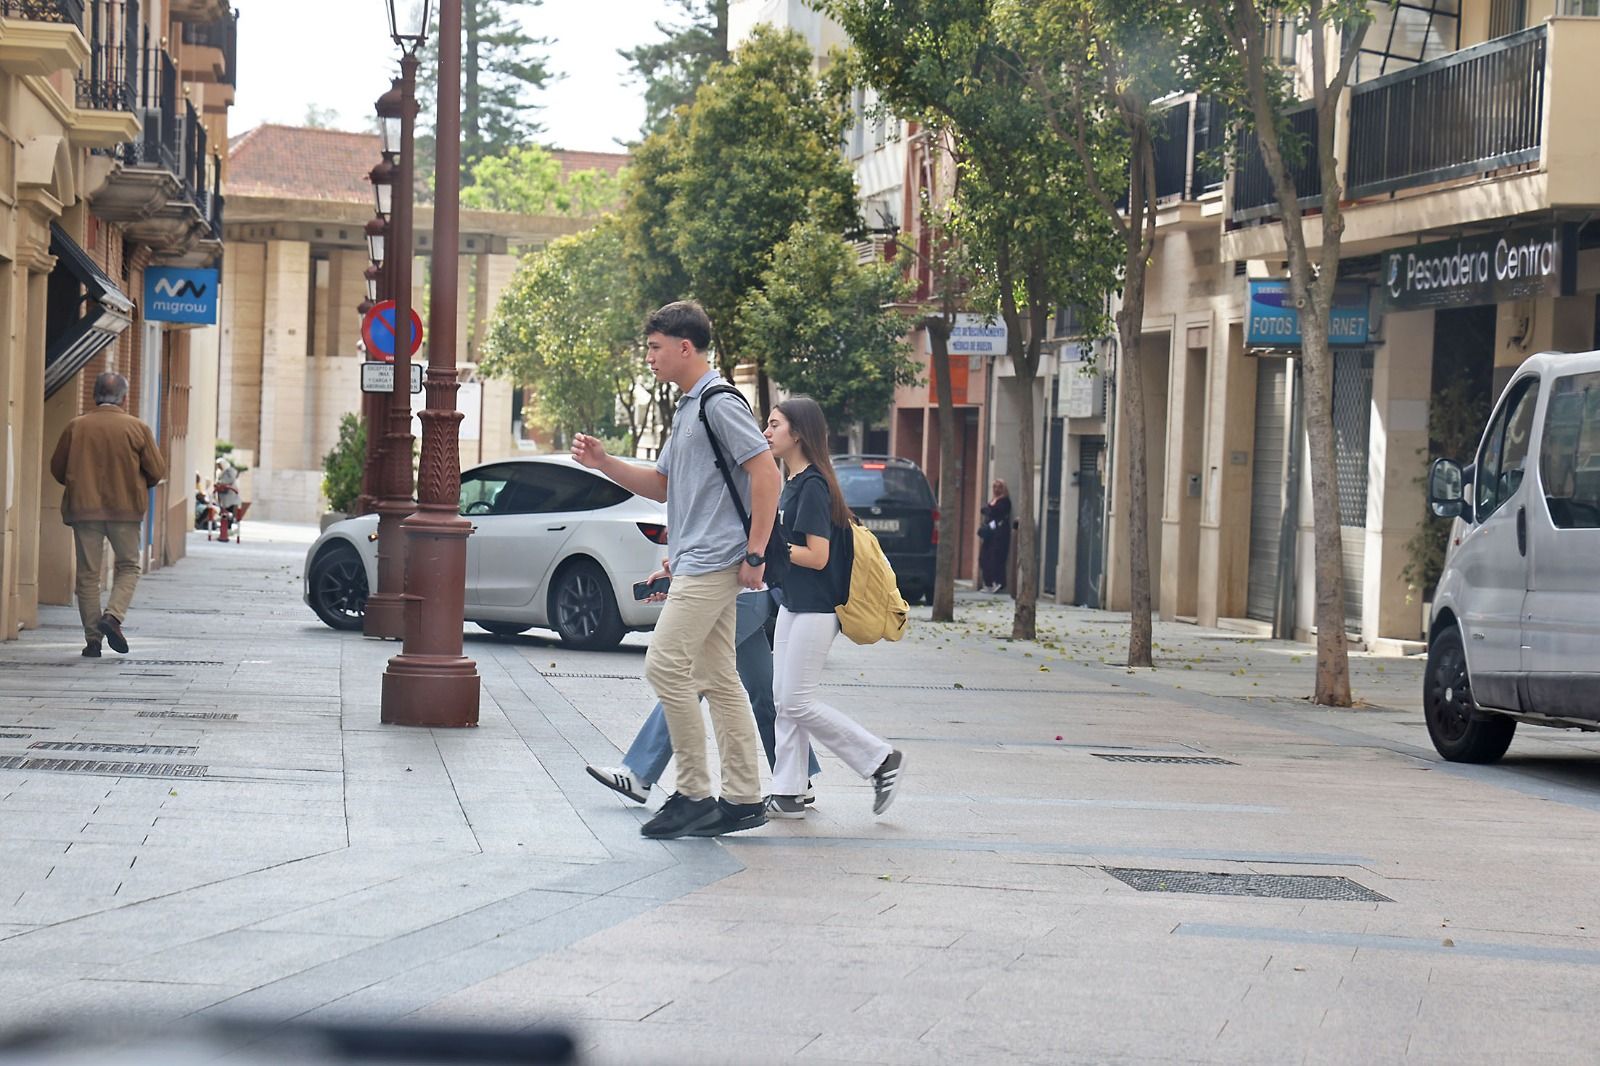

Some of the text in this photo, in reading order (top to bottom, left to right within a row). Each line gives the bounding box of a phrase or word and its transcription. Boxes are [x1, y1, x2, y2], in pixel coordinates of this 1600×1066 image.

[1495, 228, 1557, 281] Central
[153, 301, 207, 315] migrow
[1252, 317, 1292, 336] FOTOS
[1328, 317, 1365, 336] ARNET
